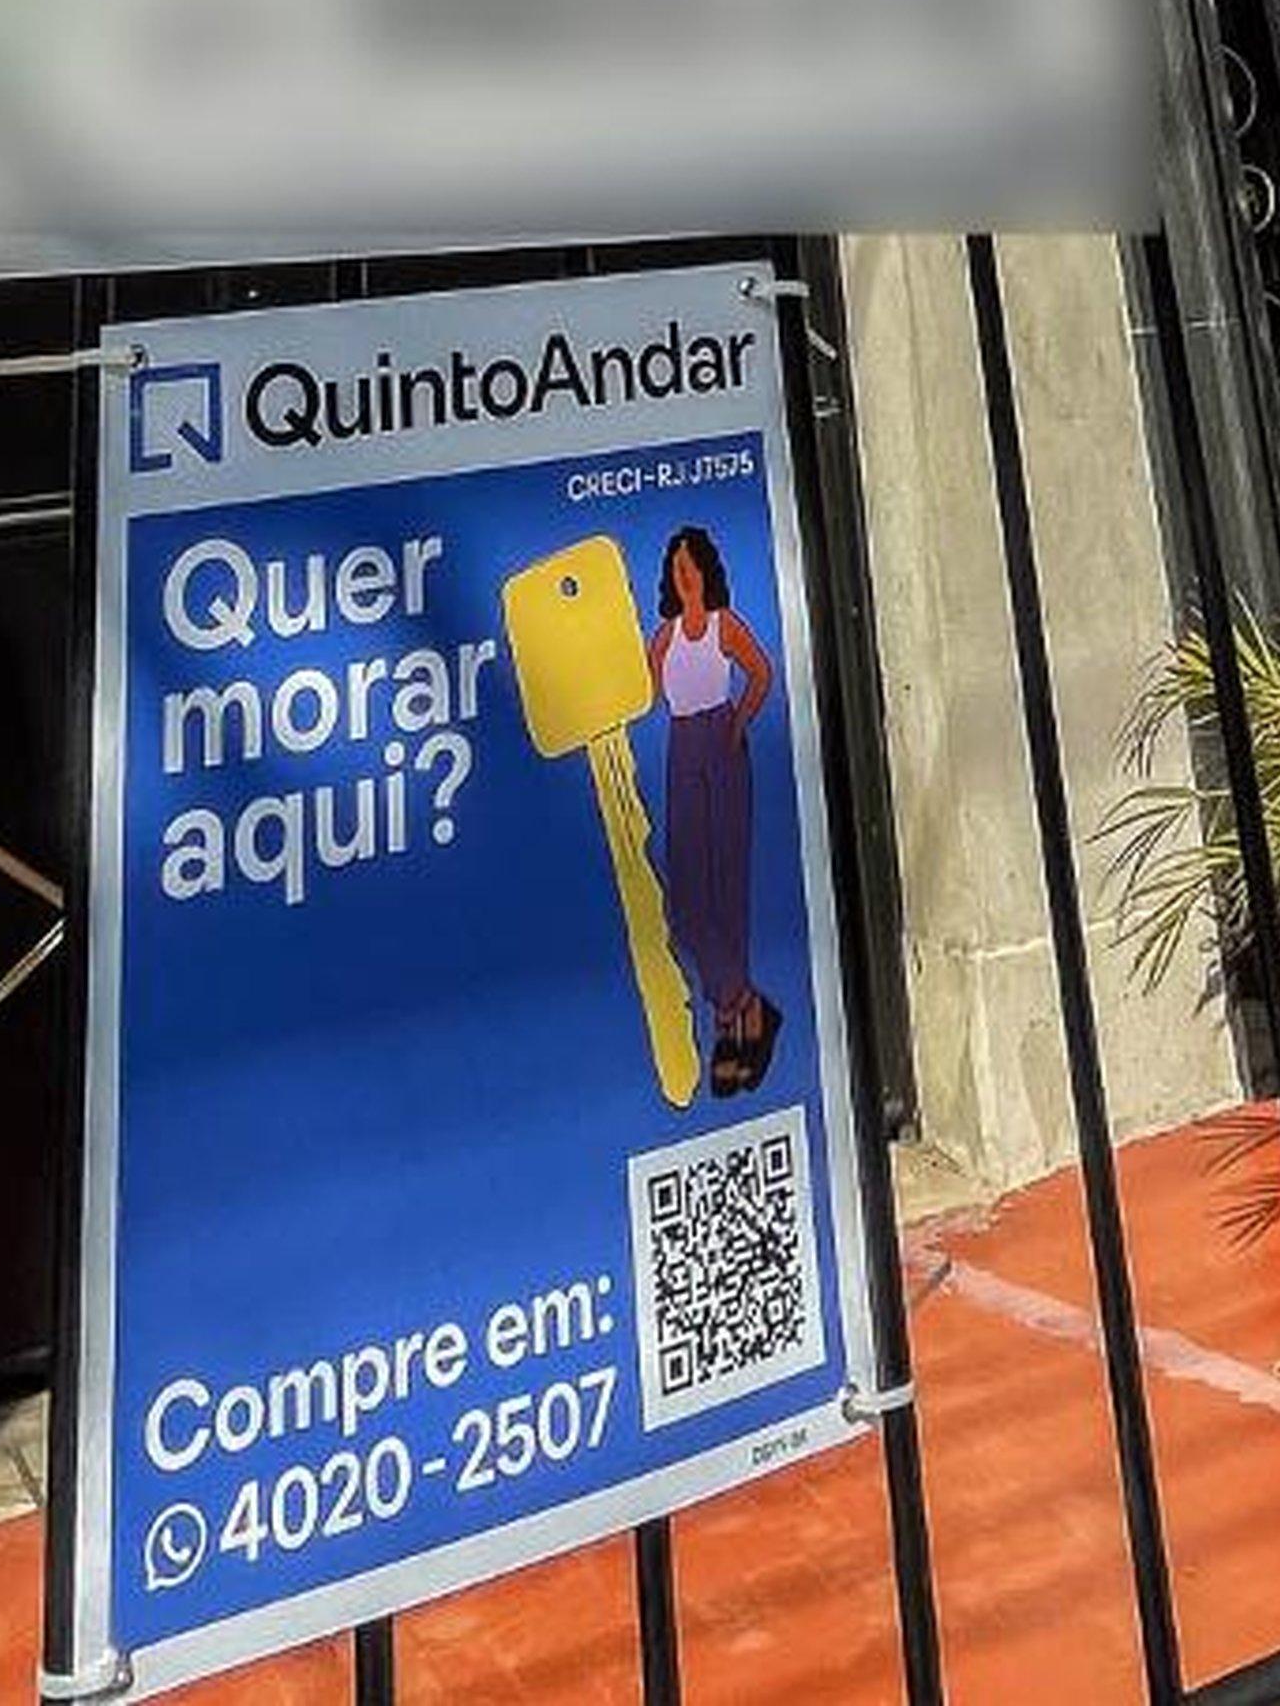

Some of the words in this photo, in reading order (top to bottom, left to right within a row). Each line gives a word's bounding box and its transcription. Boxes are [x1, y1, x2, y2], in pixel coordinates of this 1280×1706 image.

[244, 323, 756, 447] QuintoAndar
[164, 532, 442, 650] Quer
[162, 638, 496, 773] morar
[162, 733, 471, 904] aqui?
[144, 1321, 467, 1472] Compre
[486, 1274, 615, 1366] em:
